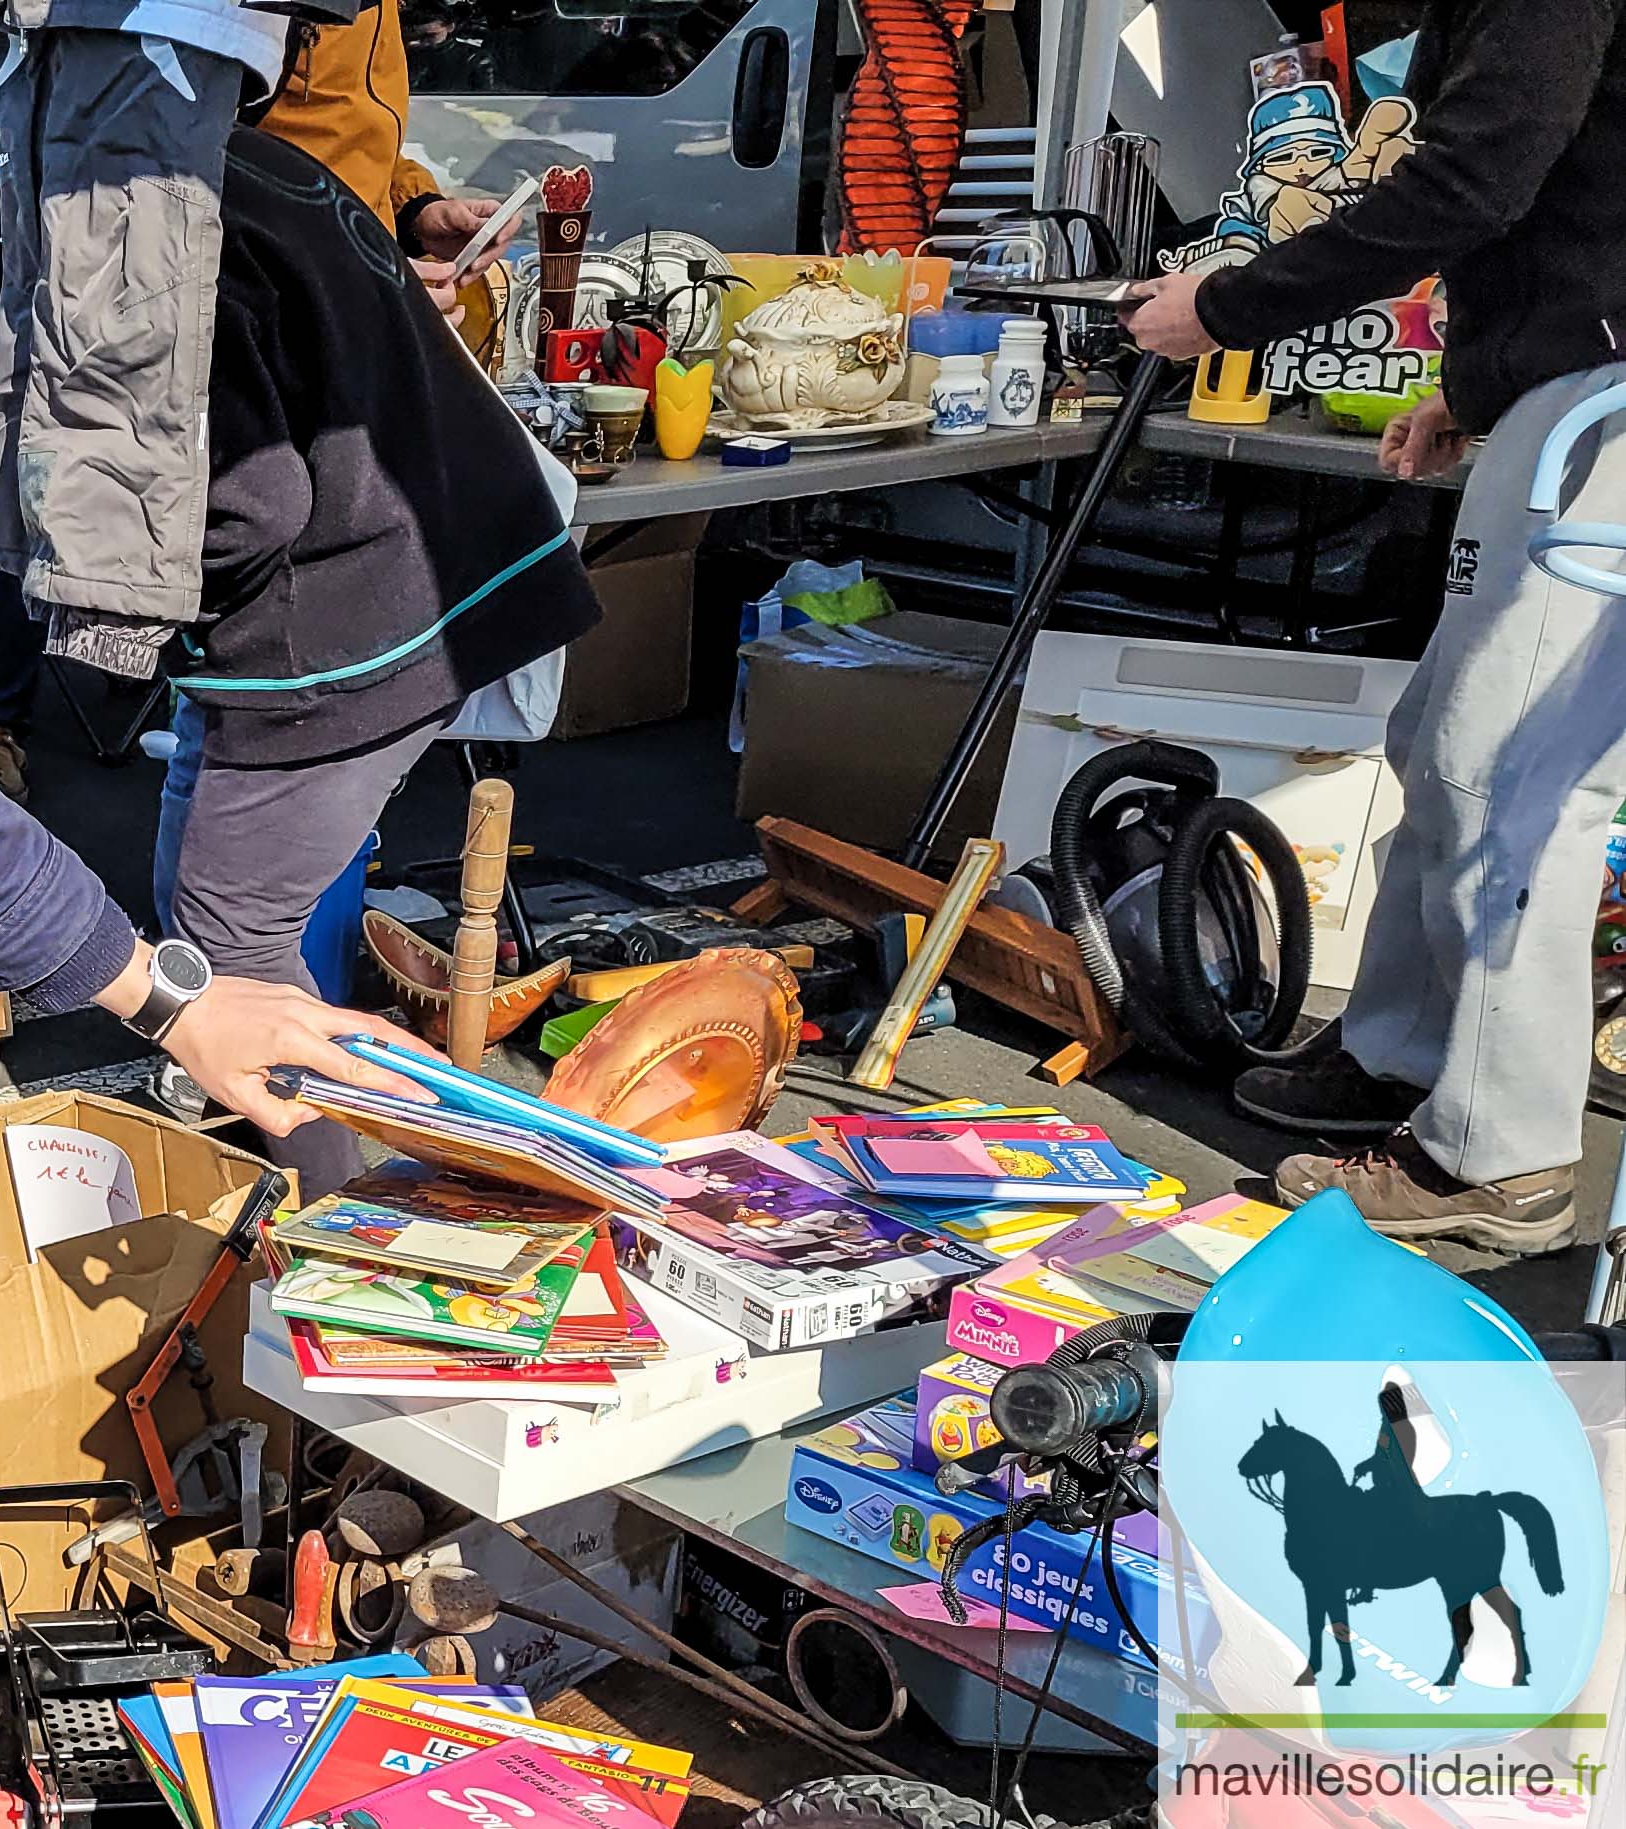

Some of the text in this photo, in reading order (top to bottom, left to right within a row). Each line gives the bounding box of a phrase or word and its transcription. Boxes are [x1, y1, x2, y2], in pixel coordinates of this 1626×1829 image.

[1269, 337, 1420, 390] fear
[668, 1260, 686, 1280] 60
[937, 1242, 990, 1267] Nathan
[821, 1275, 860, 1289] 60
[748, 1301, 772, 1322] Nathan
[849, 1303, 864, 1327] 60
[974, 1302, 1006, 1326] Disney
[780, 1312, 791, 1346] Nathan
[953, 1319, 1021, 1357] MINNIE
[797, 1479, 840, 1511] Disney
[992, 1544, 1095, 1602] 80 jeux
[685, 1553, 769, 1633] Energizer
[971, 1568, 1110, 1635] classiques
[364, 1707, 396, 1719] DEUX
[401, 1717, 471, 1739] AVENTURES
[568, 1759, 631, 1780] FANTASIO
[496, 1759, 525, 1775] des
[520, 1775, 559, 1796] gags
[557, 1797, 580, 1809] de
[510, 1754, 559, 1784] album
[574, 1792, 628, 1812] 16
[638, 1774, 672, 1796] 11
